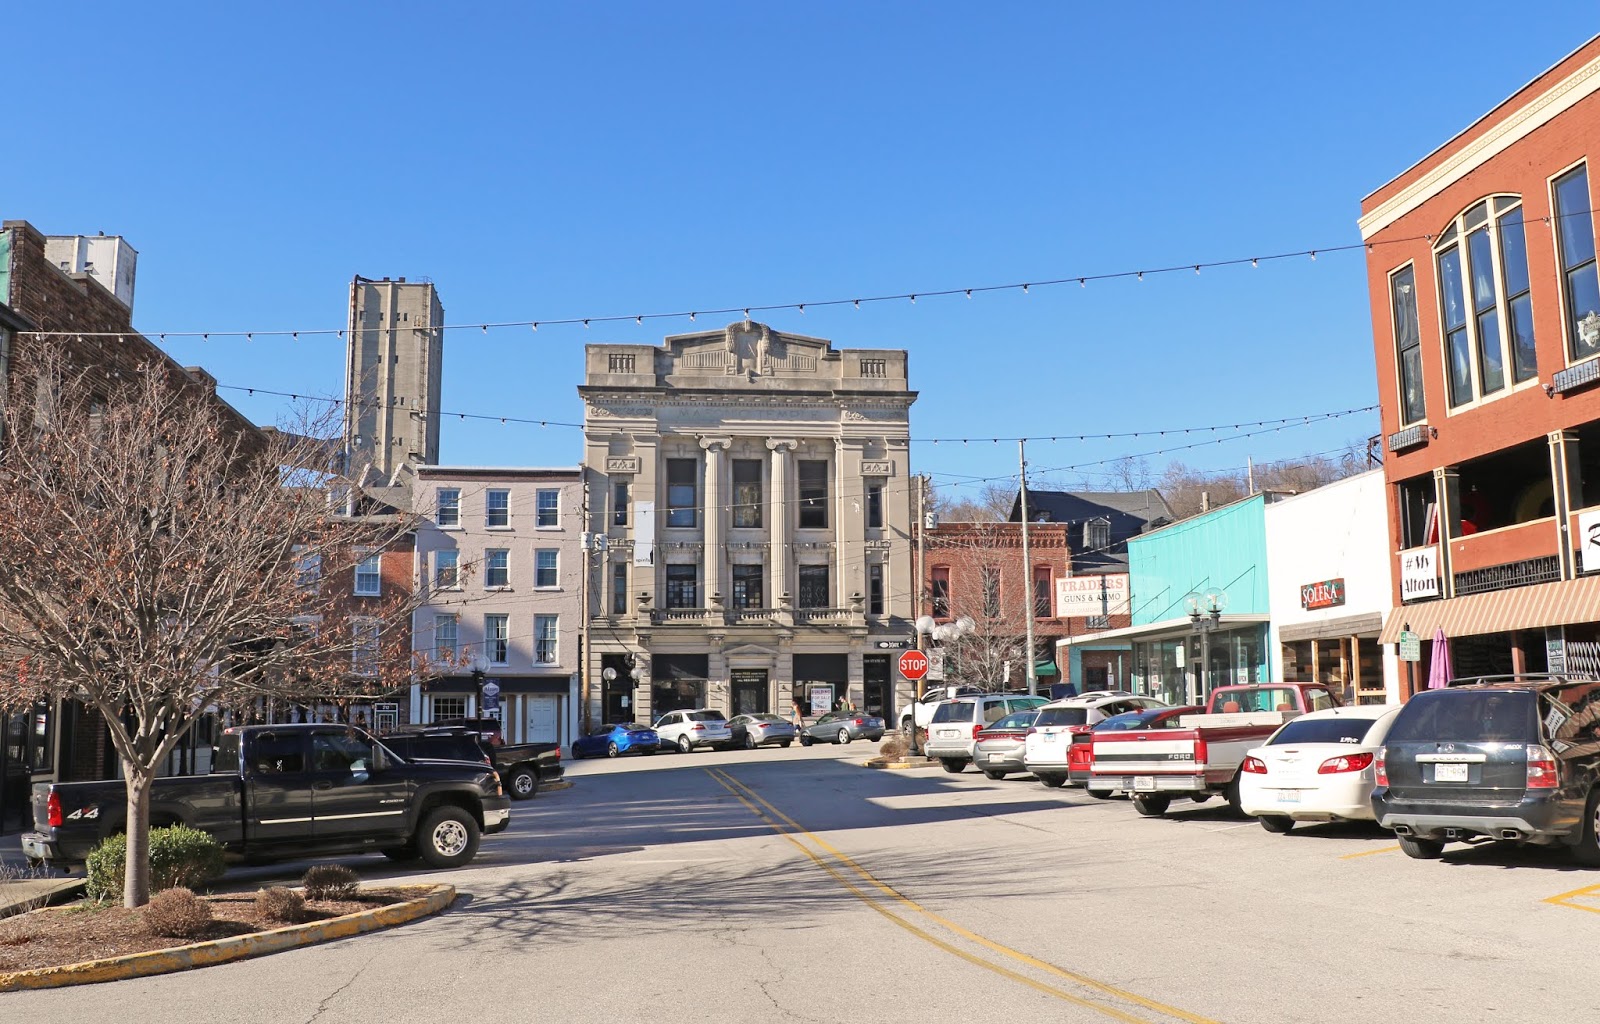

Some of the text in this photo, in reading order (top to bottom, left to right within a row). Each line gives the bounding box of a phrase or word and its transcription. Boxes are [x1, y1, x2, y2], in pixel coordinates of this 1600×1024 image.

[1060, 578, 1123, 592] TRADERS
[1404, 577, 1436, 593] Alton
[1063, 592, 1121, 603] GUNS & AMMO
[1302, 584, 1338, 604] SOLERA
[900, 659, 927, 671] STOP
